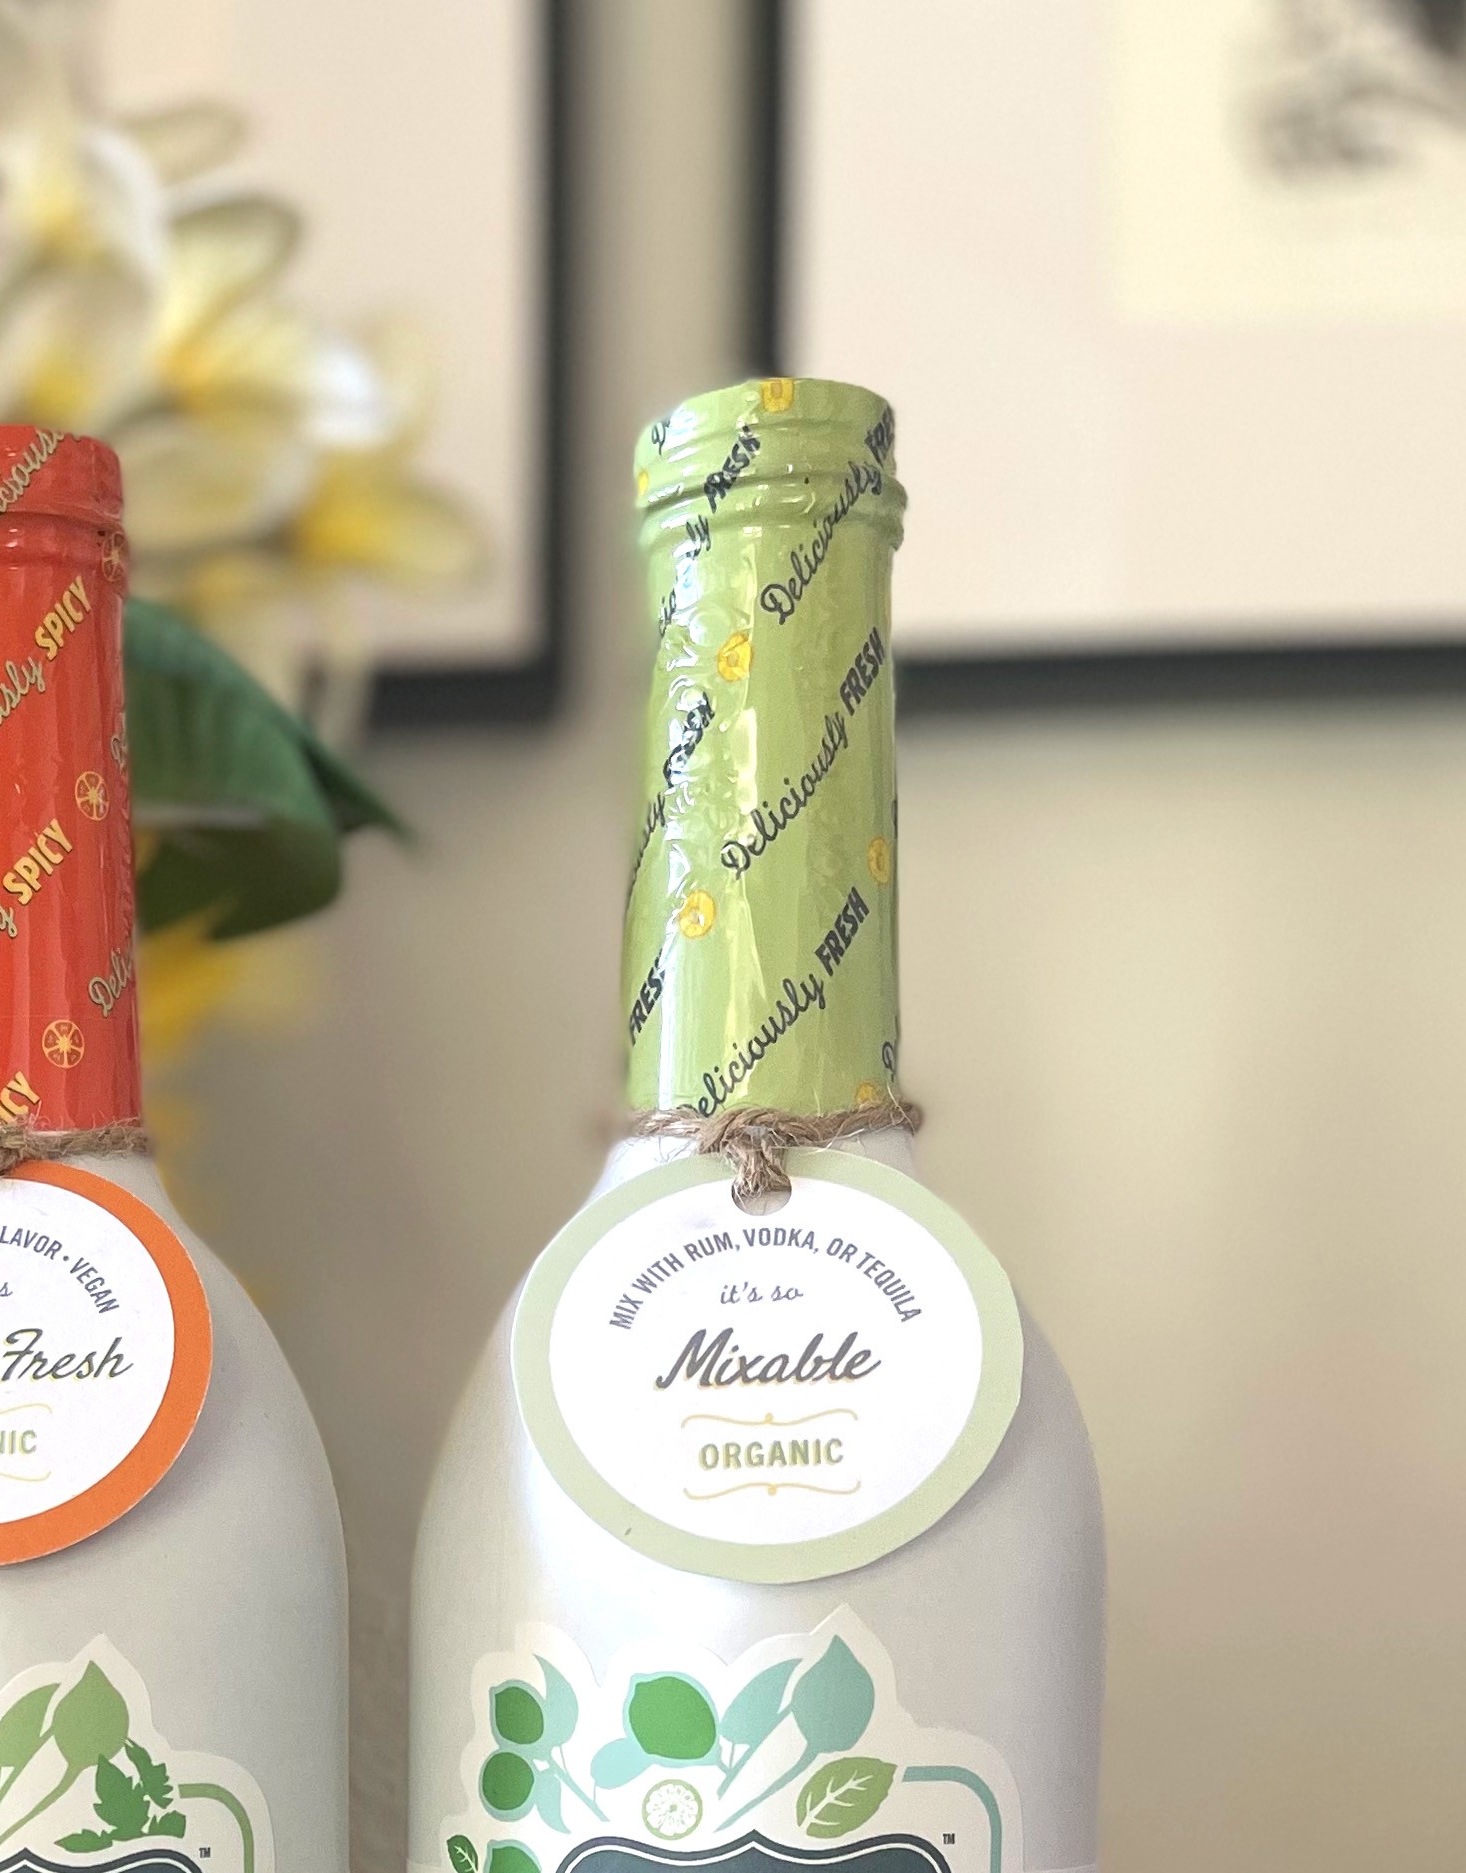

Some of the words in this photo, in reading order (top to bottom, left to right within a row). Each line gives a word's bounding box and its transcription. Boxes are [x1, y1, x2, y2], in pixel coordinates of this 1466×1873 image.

[759, 459, 883, 626] Deliciously
[34, 575, 94, 662] SPICY
[719, 711, 849, 881] Deliciously
[838, 626, 885, 718] FRESH
[2, 817, 74, 906] SPICY
[680, 973, 826, 1119] eliciously
[813, 885, 871, 977] FRESH
[68, 1256, 121, 1315] VEGAN
[609, 1292, 644, 1331] MIX
[631, 1252, 686, 1296] WITH
[684, 1230, 741, 1263] RUM,
[742, 1226, 820, 1255] VODKA,
[825, 1236, 859, 1264] OR
[855, 1250, 923, 1324] TEQUILA
[719, 1281, 764, 1305] it's
[770, 1285, 804, 1302] so
[0, 1327, 135, 1383] Fresh
[653, 1326, 883, 1391] Mixable
[697, 1437, 845, 1472] ORGANIC
